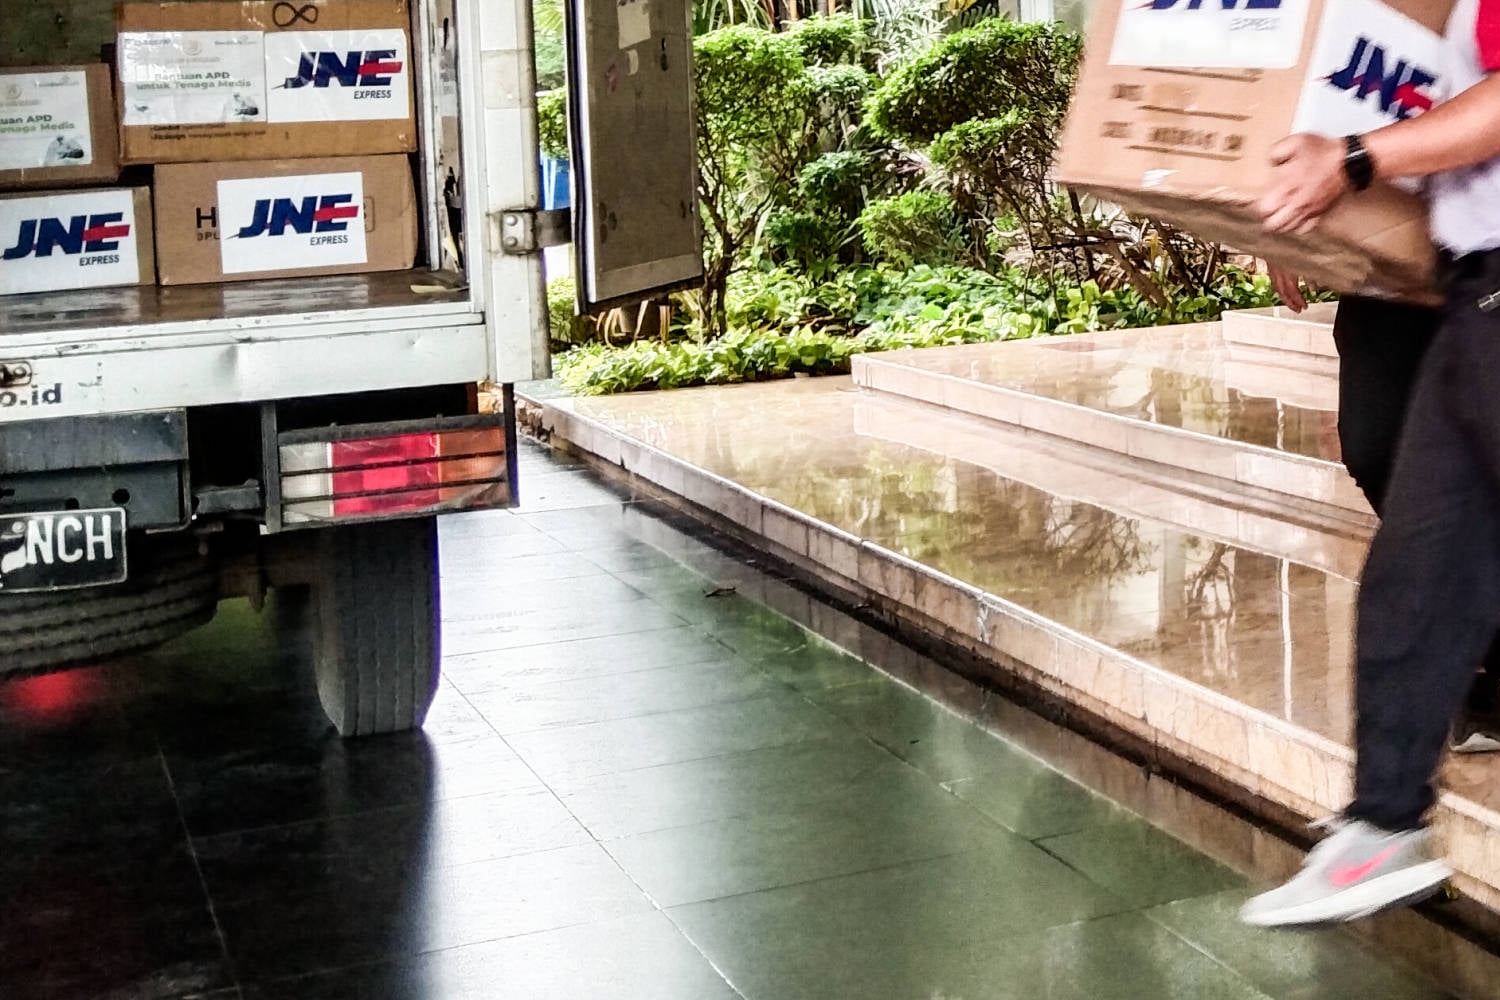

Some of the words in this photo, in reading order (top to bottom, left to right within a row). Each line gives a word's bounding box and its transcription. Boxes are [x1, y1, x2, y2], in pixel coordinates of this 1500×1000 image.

[205, 71, 231, 80] APD
[282, 49, 404, 89] JNE
[1324, 37, 1438, 120] JNE
[353, 89, 392, 100] EXPRESS
[26, 114, 54, 123] APD
[237, 193, 360, 239] JNE
[2, 212, 131, 261] JNE
[310, 234, 349, 246] EXPRESS
[79, 254, 121, 267] EXPRESS
[25, 513, 114, 565] NCH
